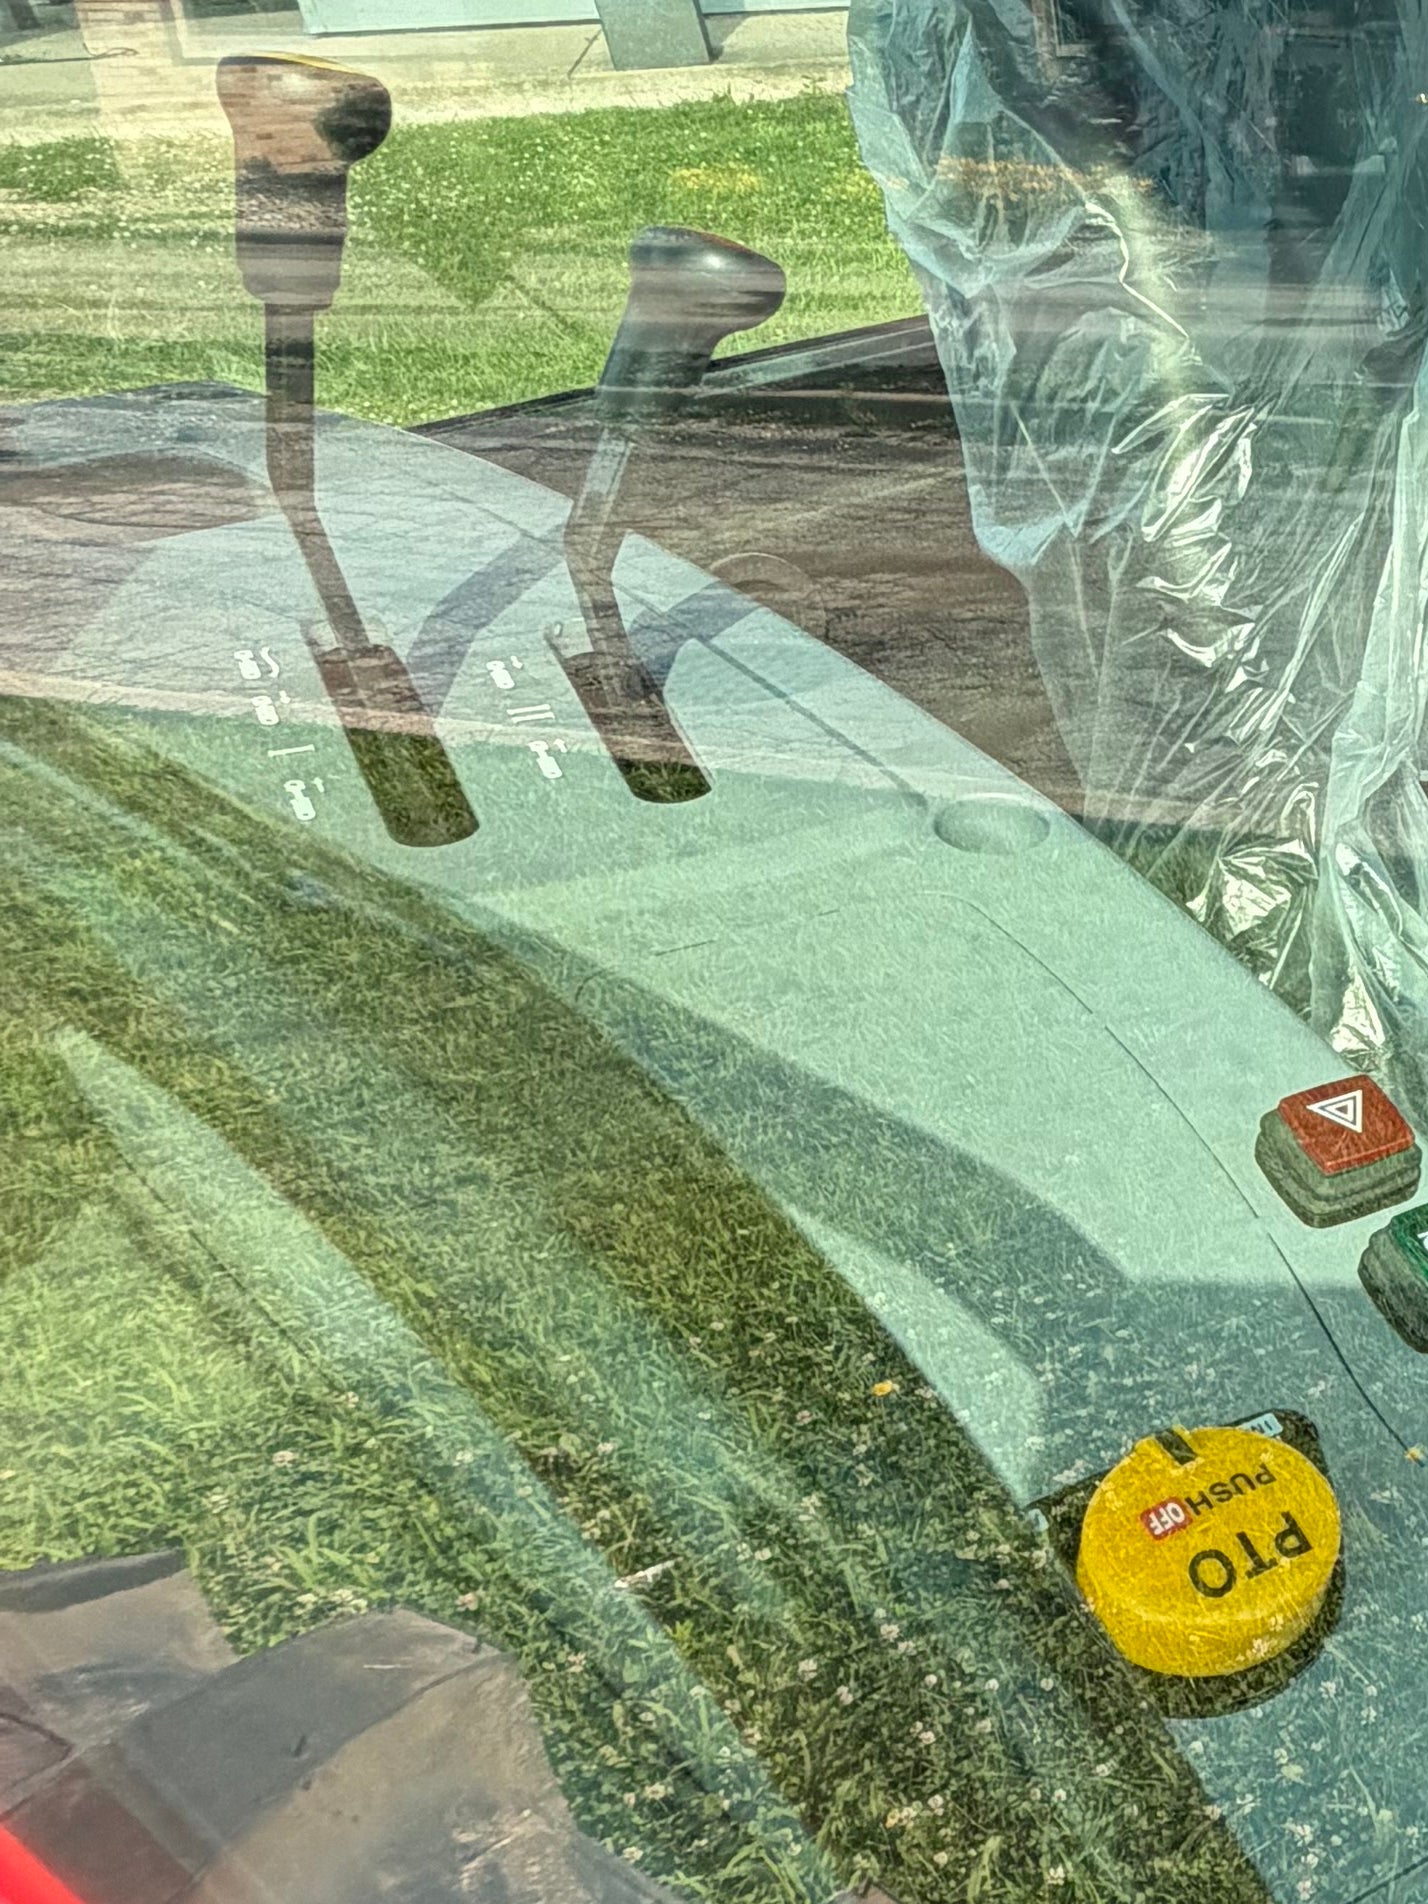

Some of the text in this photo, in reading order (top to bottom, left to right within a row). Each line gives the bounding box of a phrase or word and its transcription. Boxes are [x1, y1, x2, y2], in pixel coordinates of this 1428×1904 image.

[1149, 1463, 1277, 1536] PUSH OFF
[1188, 1511, 1313, 1599] PTO
